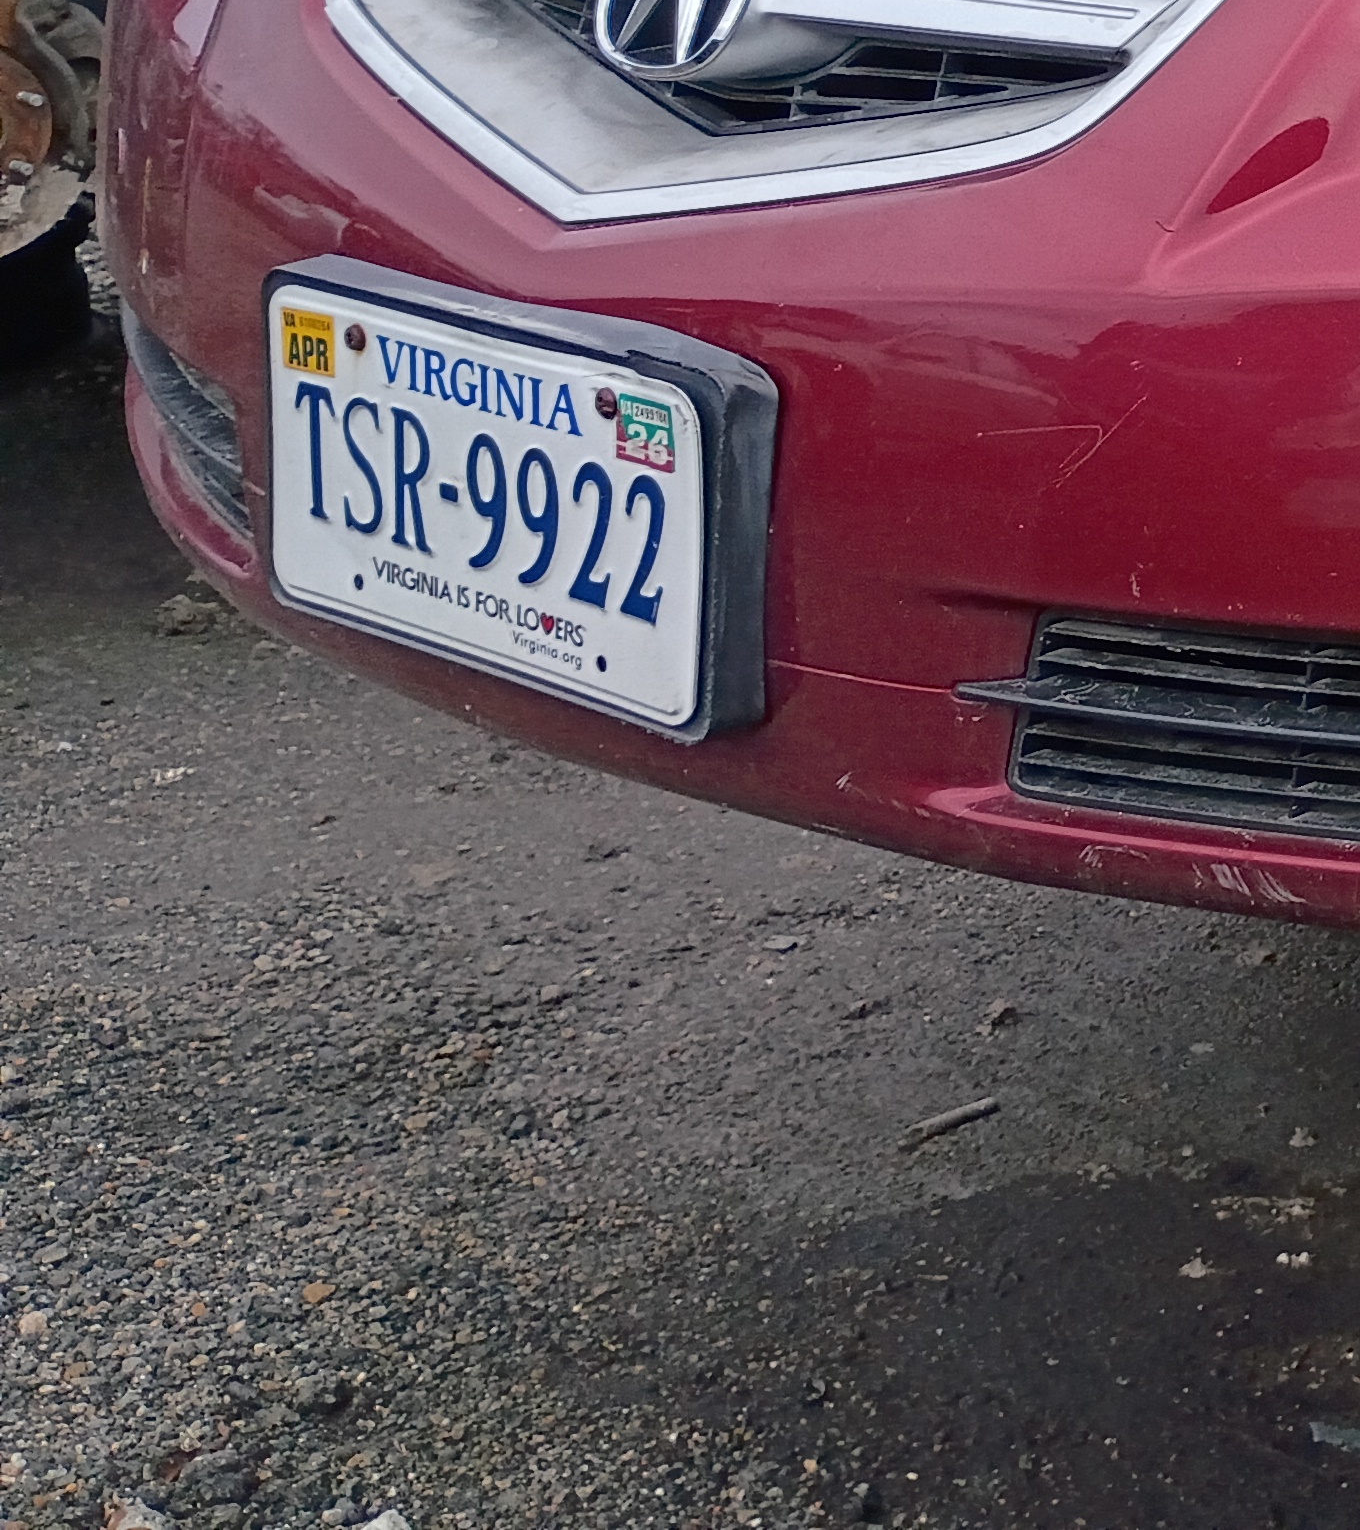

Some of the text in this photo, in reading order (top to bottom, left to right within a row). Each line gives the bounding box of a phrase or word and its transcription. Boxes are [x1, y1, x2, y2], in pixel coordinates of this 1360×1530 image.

[289, 333, 330, 372] APR
[376, 335, 583, 437] VIRGINIA
[295, 381, 666, 626] TSR-9922
[372, 556, 453, 604] VIRGINIA
[456, 584, 470, 609] IS
[474, 590, 513, 624] FOR
[512, 630, 584, 671] Virginia.org
